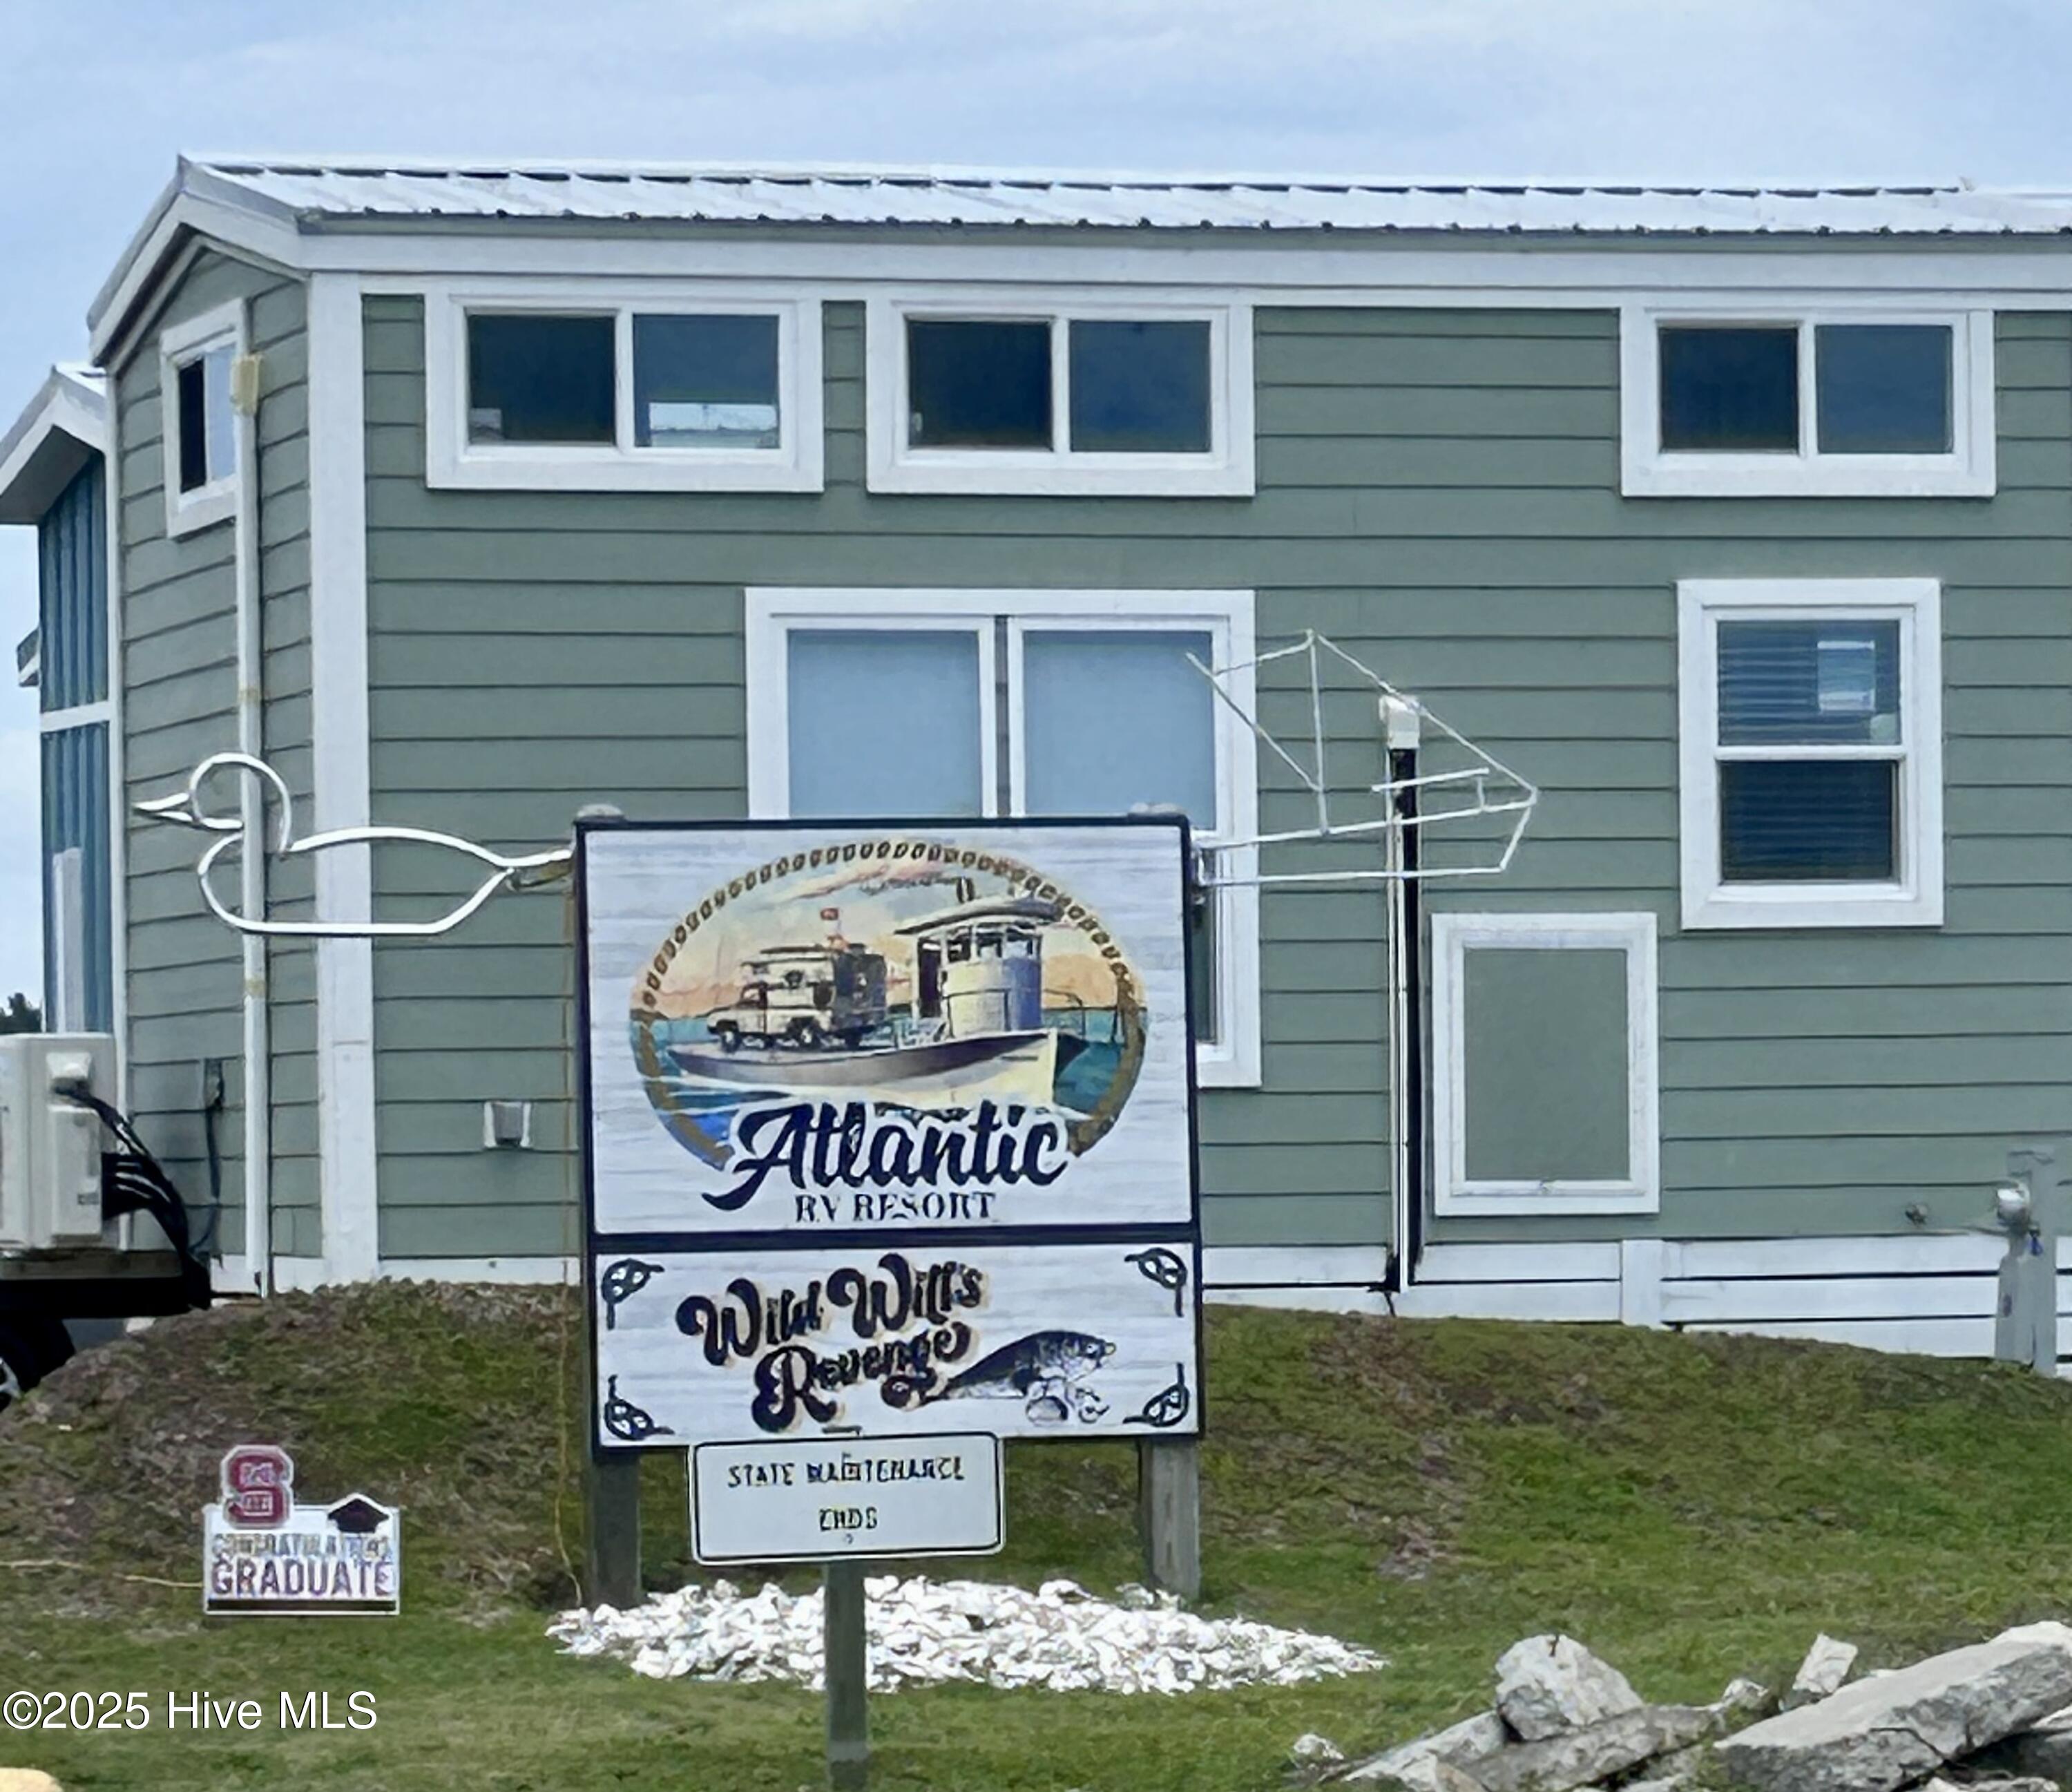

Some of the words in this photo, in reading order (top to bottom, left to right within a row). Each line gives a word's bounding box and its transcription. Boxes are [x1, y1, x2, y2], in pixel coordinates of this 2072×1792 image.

[702, 1100, 1068, 1211] Atlantic
[796, 1194, 837, 1223] RV
[854, 1191, 997, 1222] RESORT
[676, 1277, 823, 1366] Wild
[751, 1321, 972, 1433] Revenge
[728, 1462, 794, 1487] STATE
[819, 1505, 878, 1531] ENDS
[212, 1559, 392, 1596] GRADUATE
